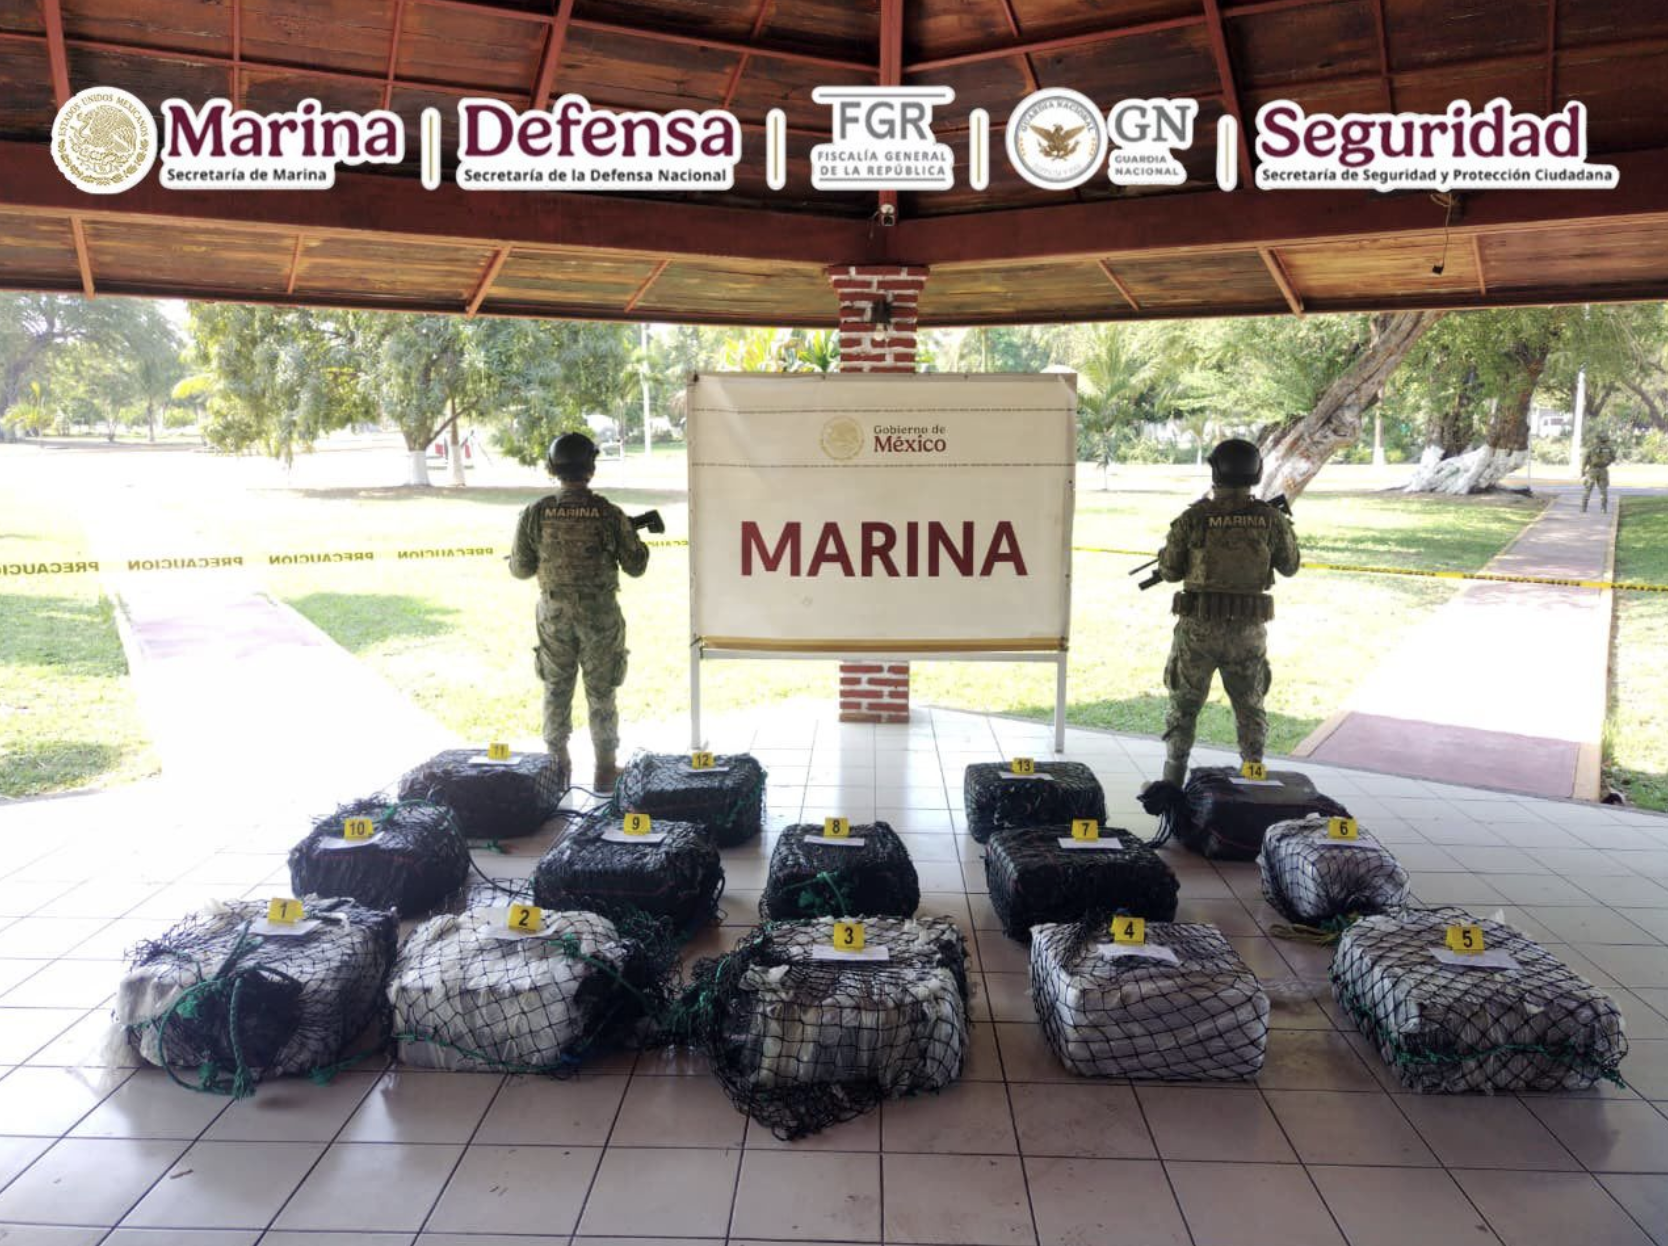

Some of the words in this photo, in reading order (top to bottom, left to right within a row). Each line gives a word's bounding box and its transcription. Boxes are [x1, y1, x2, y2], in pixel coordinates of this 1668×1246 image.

[874, 425, 928, 435] Gobierno
[932, 424, 946, 434] de
[874, 435, 947, 452] México
[544, 507, 600, 518] MARINA
[1210, 516, 1267, 527] MARINA
[741, 520, 1028, 577] MARINA
[494, 745, 504, 757] 11
[697, 754, 708, 766] 12
[1018, 760, 1030, 771] 13
[1249, 765, 1262, 776] 14
[350, 822, 365, 836] 10
[632, 816, 640, 830] 9
[832, 819, 840, 833] 8
[1082, 823, 1090, 836] 7
[1339, 823, 1348, 835] 6
[518, 910, 530, 926] 2
[844, 927, 854, 944] 3
[1124, 921, 1134, 938] 4
[1462, 930, 1472, 948] 5
